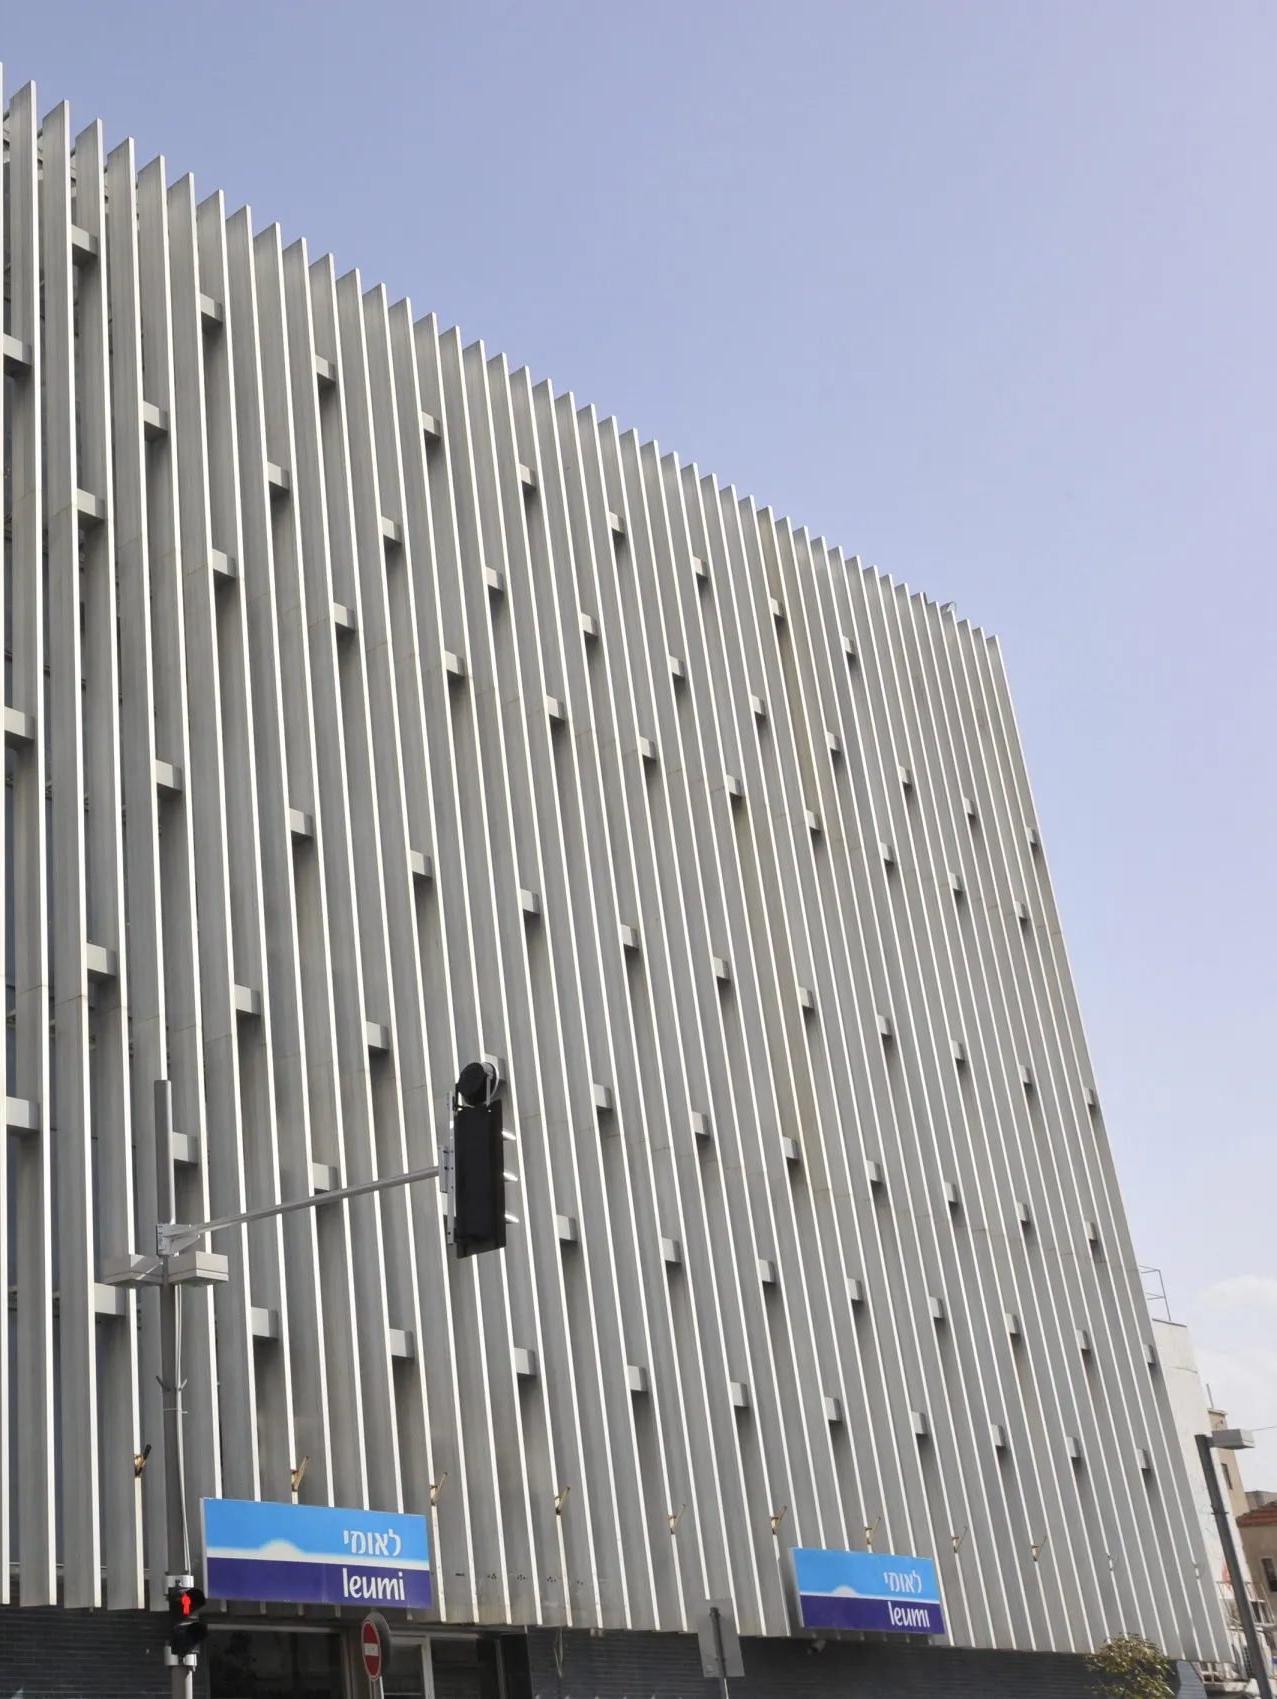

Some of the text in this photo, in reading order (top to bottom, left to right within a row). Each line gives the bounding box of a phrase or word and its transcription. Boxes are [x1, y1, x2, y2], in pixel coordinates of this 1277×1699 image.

[343, 1528, 402, 1557] לאומי
[342, 1567, 405, 1601] leumi
[883, 1569, 922, 1594] לאומי
[887, 1600, 931, 1629] leumi
